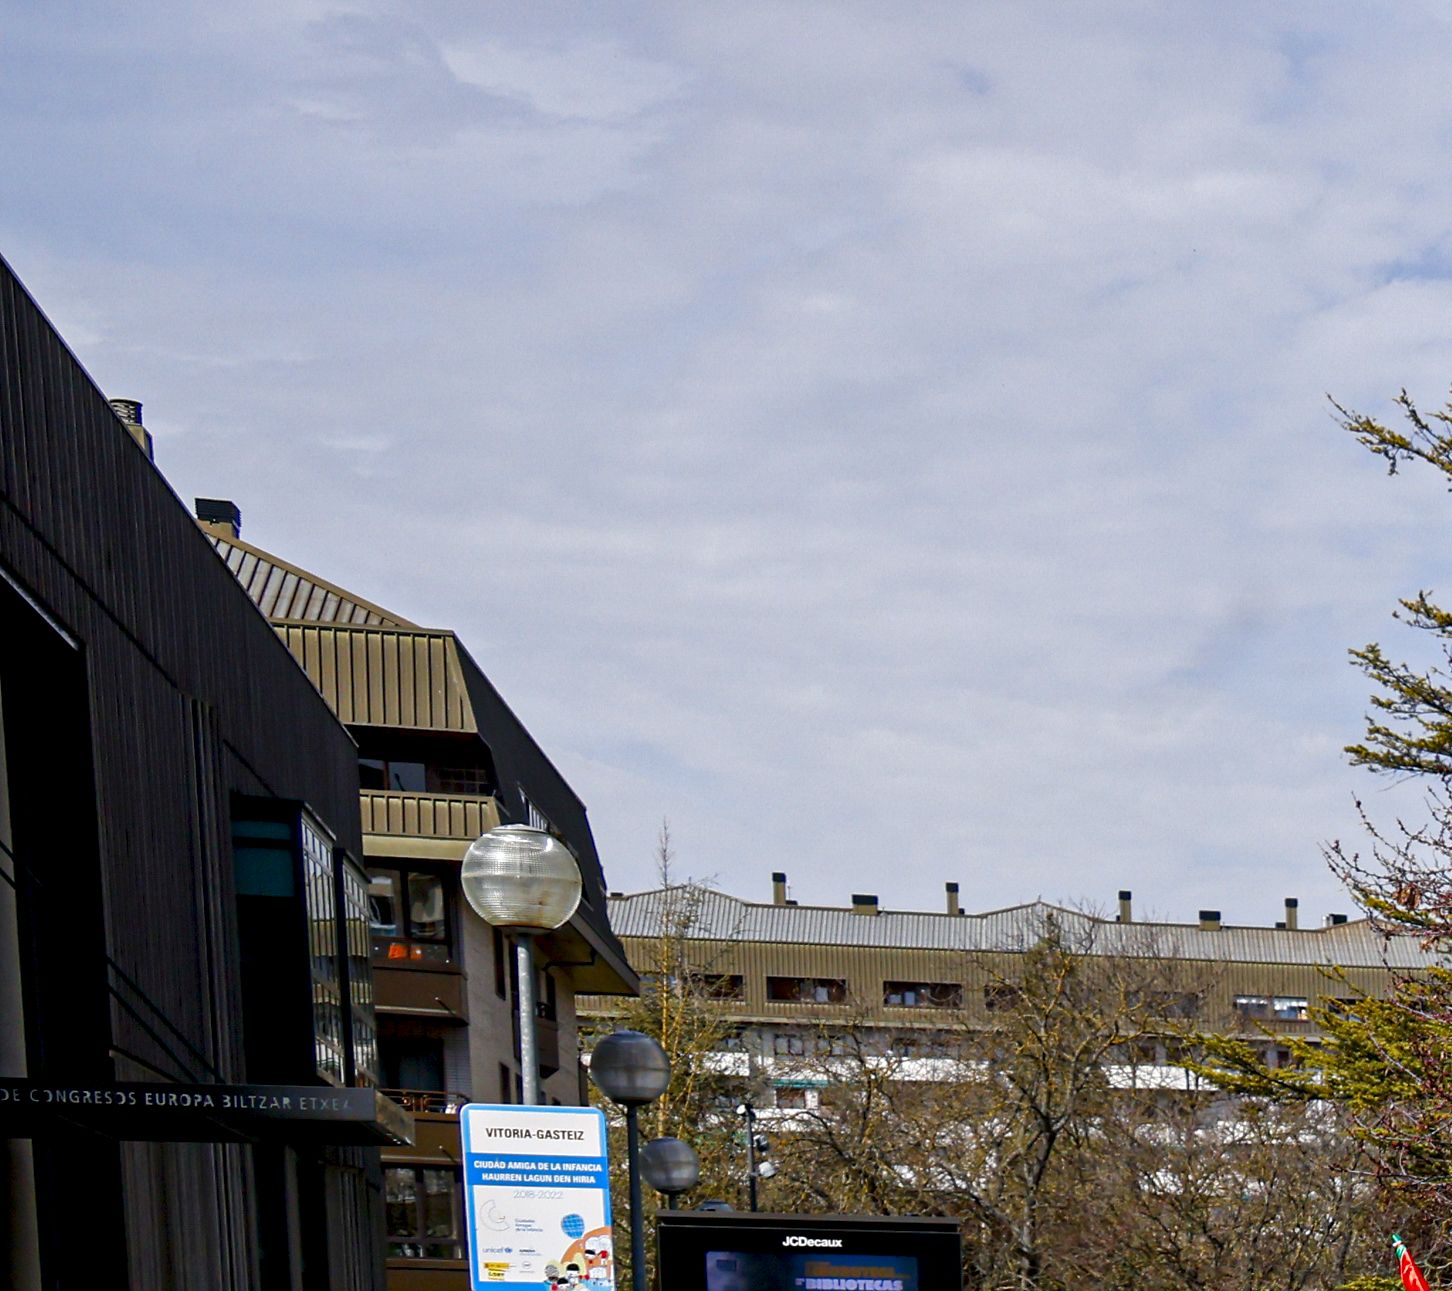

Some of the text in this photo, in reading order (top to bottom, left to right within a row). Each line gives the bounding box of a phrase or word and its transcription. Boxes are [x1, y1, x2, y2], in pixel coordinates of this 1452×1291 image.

[30, 1089, 136, 1105] CONGRESOS
[145, 1092, 214, 1108] EUROPA
[222, 1094, 292, 1110] BILTZAR
[485, 1127, 584, 1141] VITORIA-GASTEIZ
[508, 1160, 535, 1170] AMIGA
[538, 1161, 549, 1170] DE
[550, 1162, 561, 1170] LA
[563, 1162, 602, 1172] INFANCIA
[482, 1173, 596, 1184] HAURREN LAGUN DEN HIRIA
[782, 1236, 842, 1248] JCDecaux
[482, 1246, 503, 1254] unicef
[805, 1278, 904, 1291] BIBLIOTECAS
